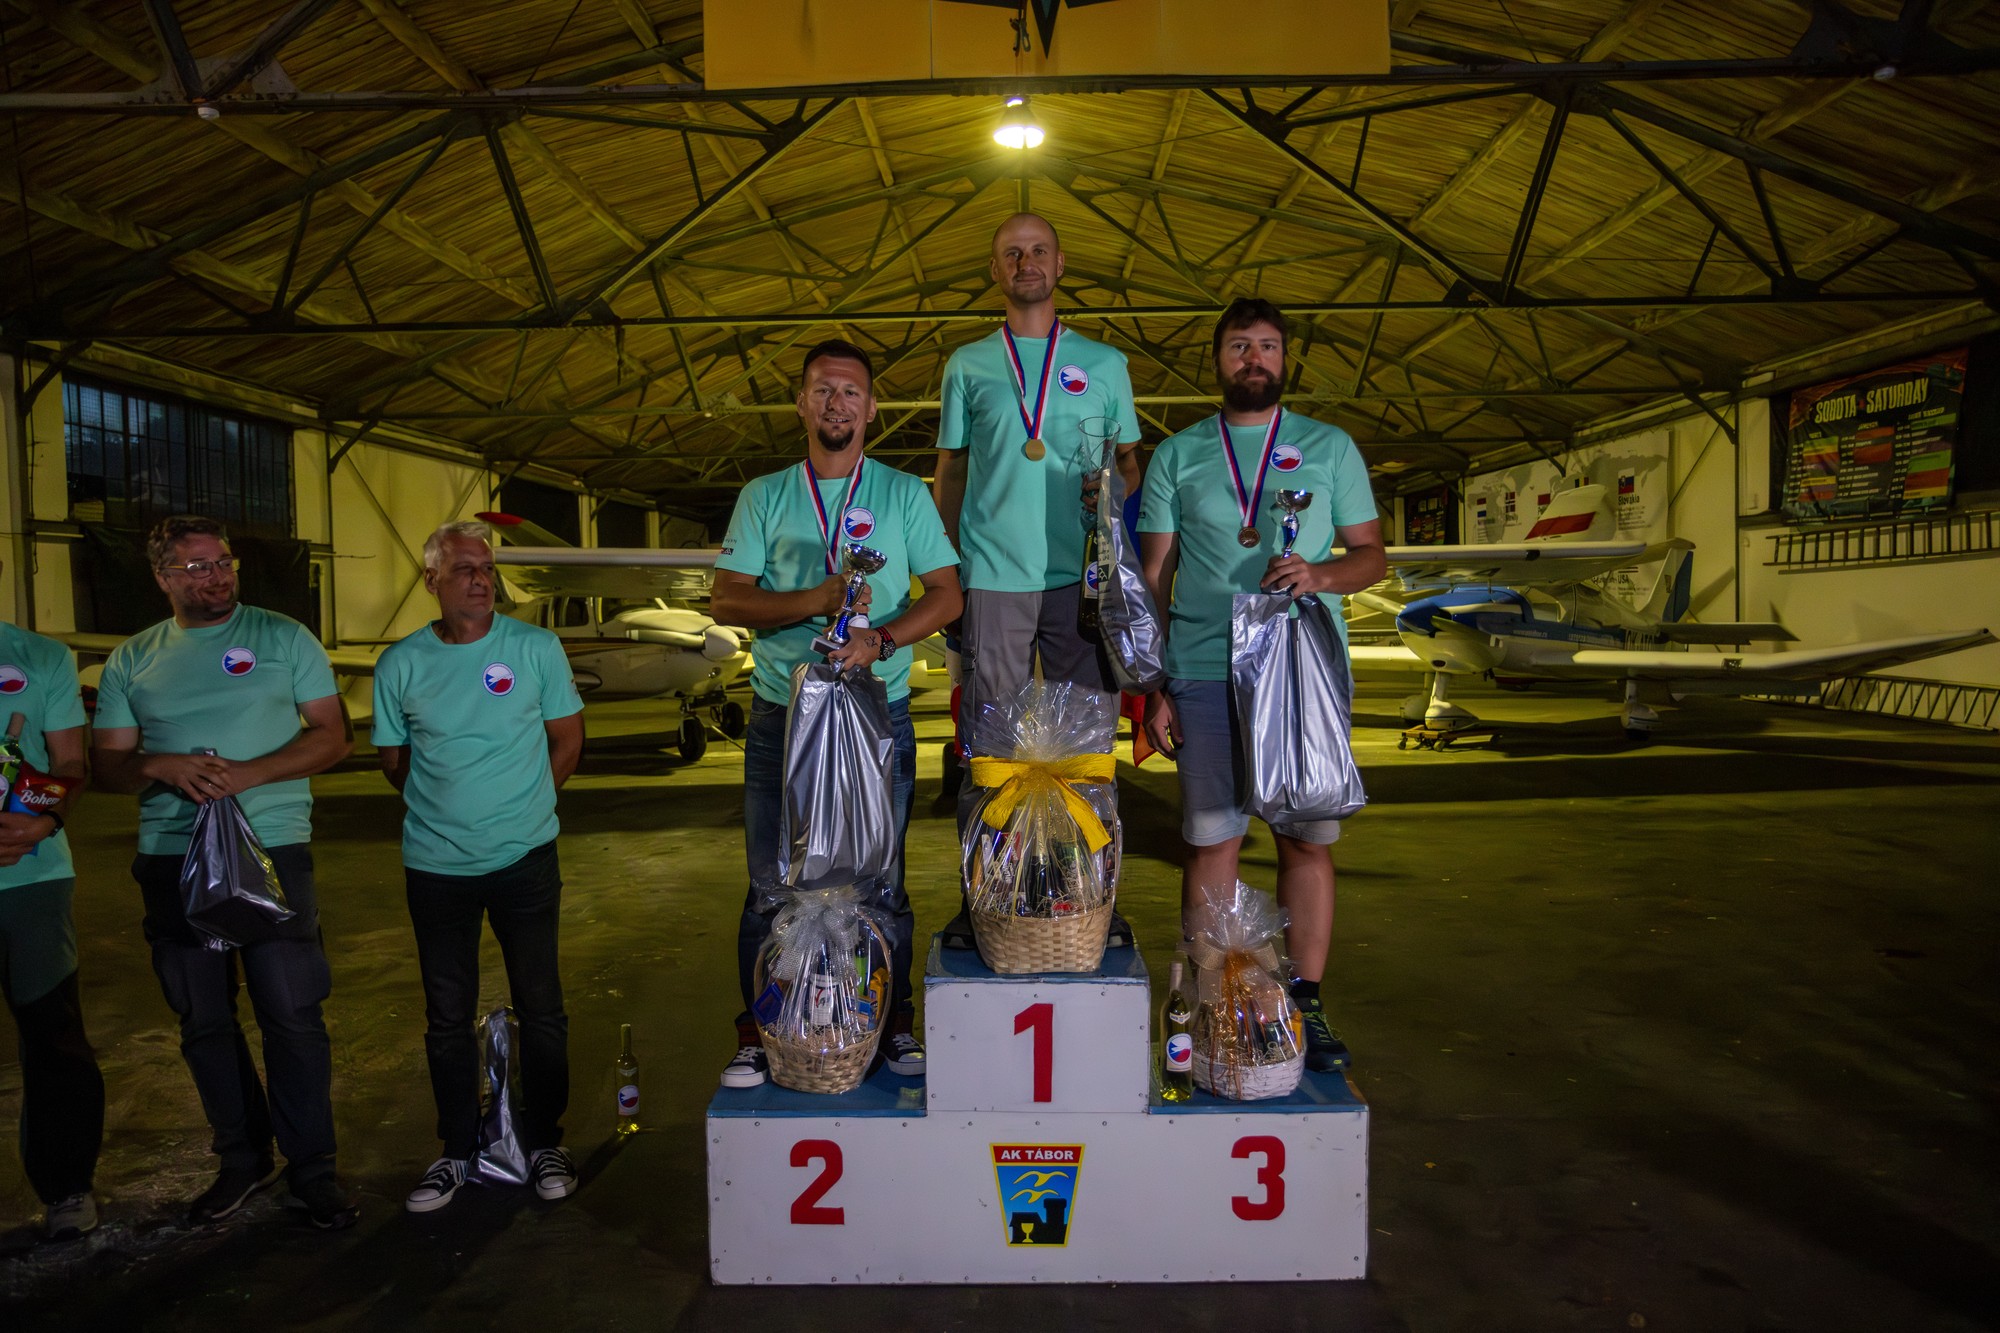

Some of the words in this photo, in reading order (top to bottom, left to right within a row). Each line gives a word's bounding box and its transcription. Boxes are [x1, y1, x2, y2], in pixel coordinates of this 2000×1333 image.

[1814, 394, 1857, 424] SOBOTA
[1866, 377, 1929, 414] SATURDAY
[1014, 1003, 1053, 1102] 1
[790, 1139, 844, 1224] 2
[1001, 1149, 1022, 1160] AK
[1025, 1147, 1074, 1160] TÁBOR
[1231, 1135, 1285, 1221] 3
